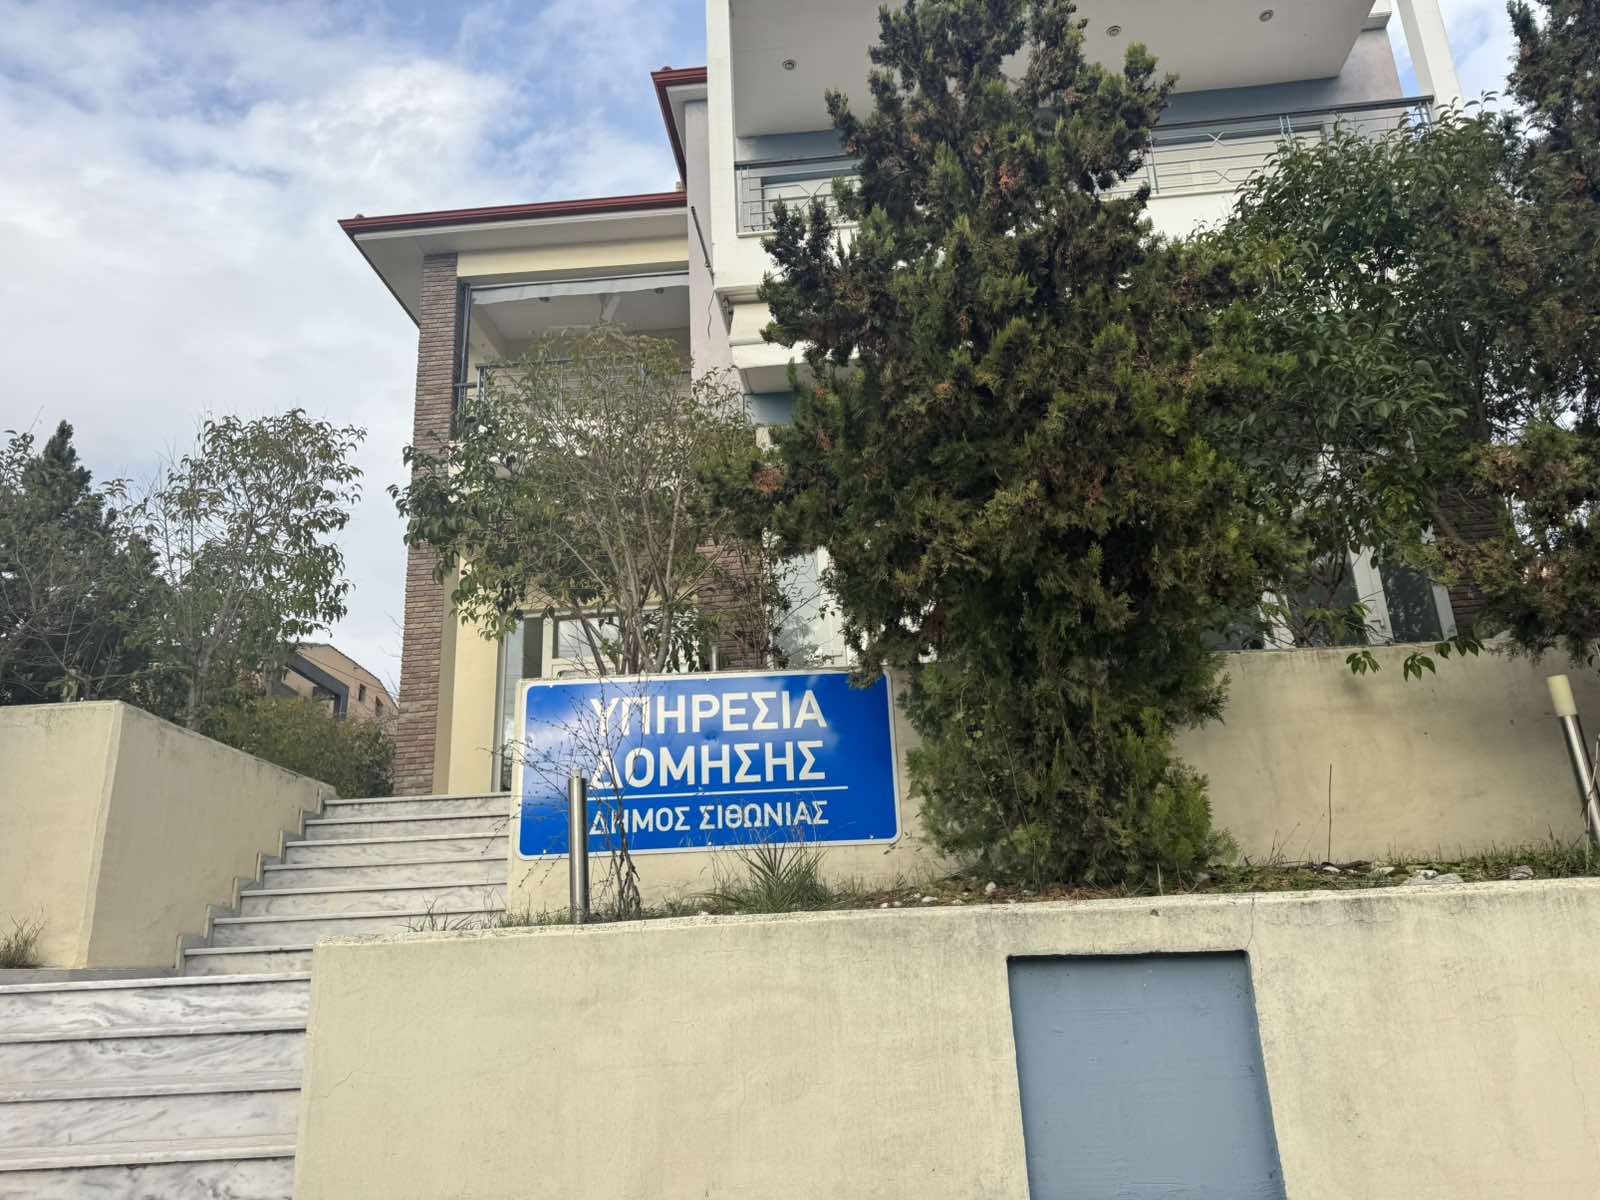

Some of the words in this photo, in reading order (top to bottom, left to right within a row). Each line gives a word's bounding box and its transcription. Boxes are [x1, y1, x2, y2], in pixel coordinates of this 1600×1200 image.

[590, 690, 827, 737] ΥΠΗΡΕΣΙΑ
[591, 740, 825, 789] ΔΟΜΗΣΗΣ
[589, 806, 691, 835] ΔΗΜΟΣ
[699, 800, 829, 830] ΣΙΘΩΝΙΑΣ
